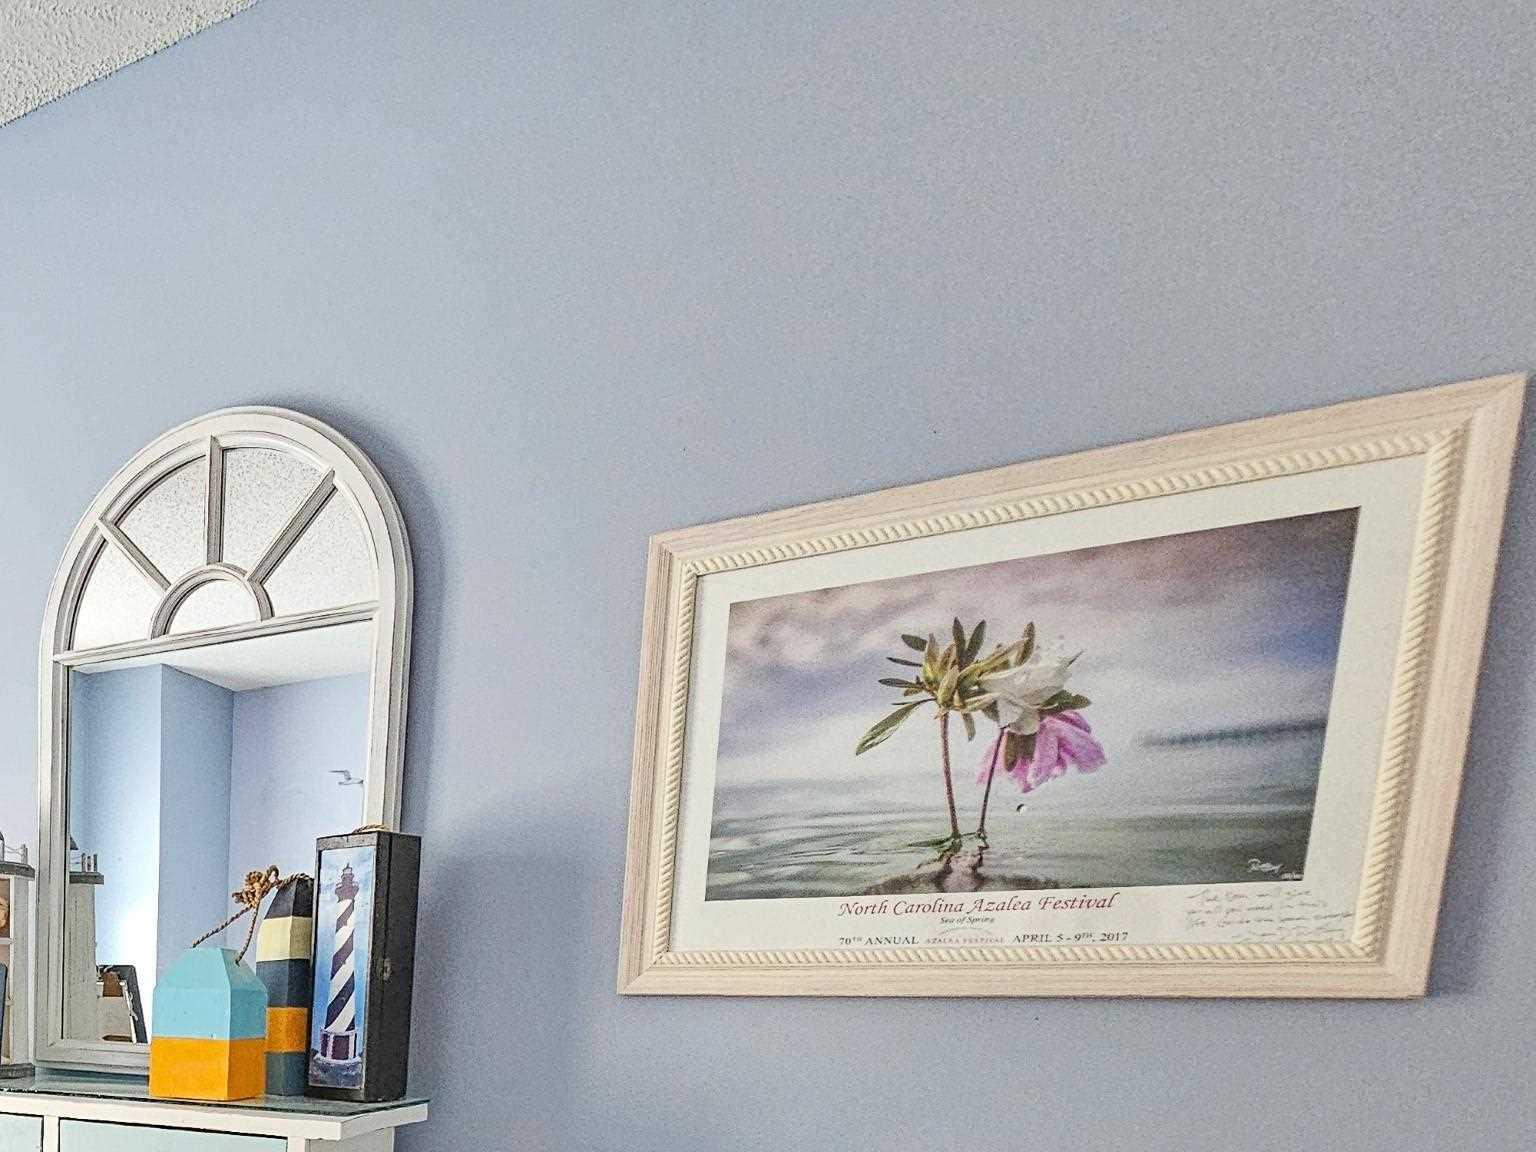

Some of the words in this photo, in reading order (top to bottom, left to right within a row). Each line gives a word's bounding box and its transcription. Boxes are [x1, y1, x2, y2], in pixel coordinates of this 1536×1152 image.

[838, 899, 889, 917] North
[893, 897, 965, 916] Carolina
[965, 895, 1032, 915] Azalea
[1038, 892, 1121, 911] Festival
[864, 936, 920, 946] ANNUAL
[1012, 933, 1052, 943] APRIL
[1099, 931, 1129, 942] 2017
